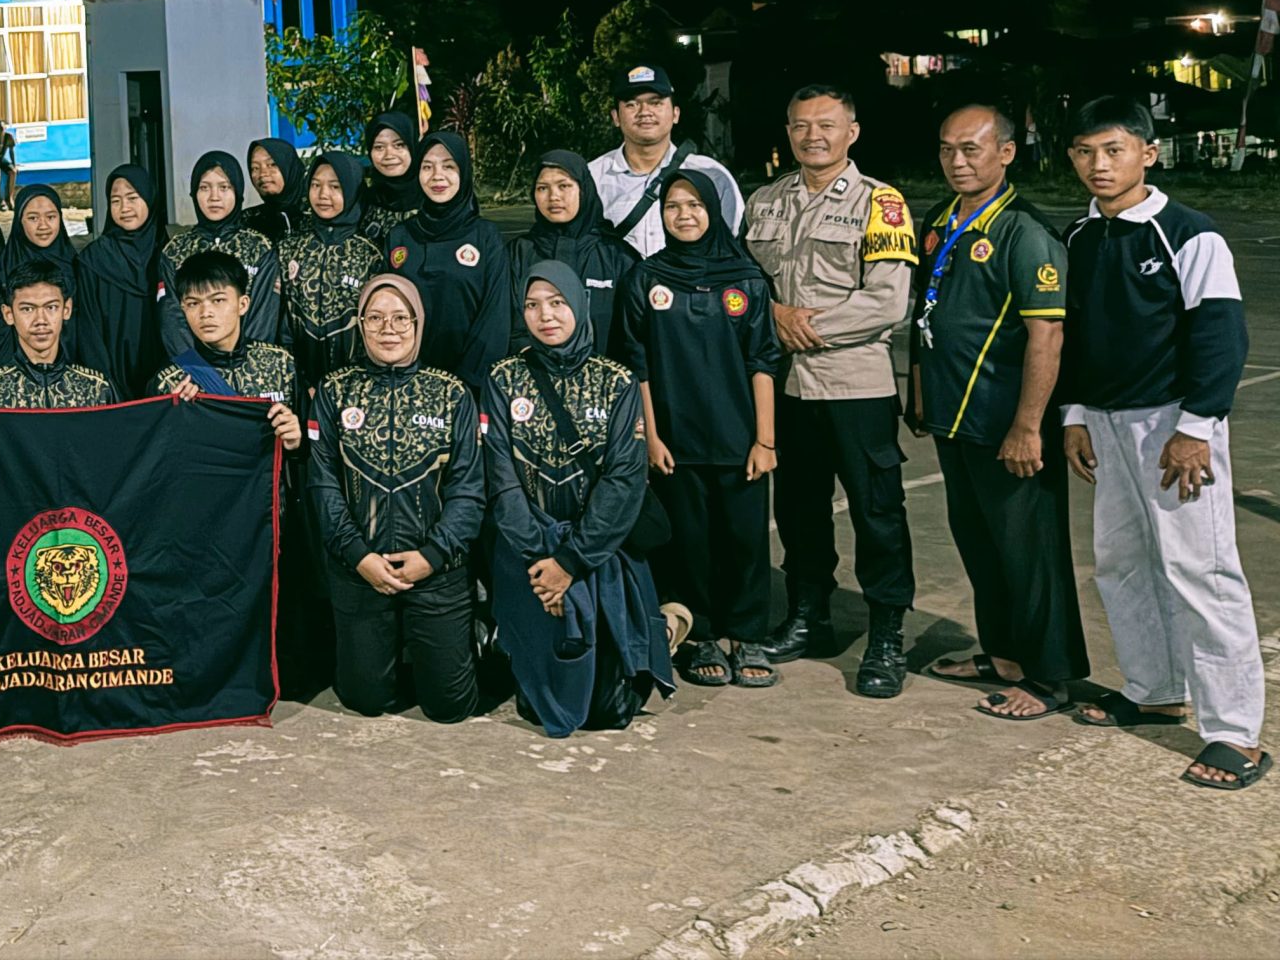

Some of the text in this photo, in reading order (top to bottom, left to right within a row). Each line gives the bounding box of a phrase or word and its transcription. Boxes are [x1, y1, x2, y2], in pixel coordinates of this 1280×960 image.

[825, 214, 864, 227] POLRI
[412, 413, 445, 429] COACH
[13, 511, 120, 560] KELUARGA BESAR
[89, 573, 125, 629] CIMANDE
[88, 648, 146, 668] BESAR
[89, 668, 174, 688] CIMANDE
